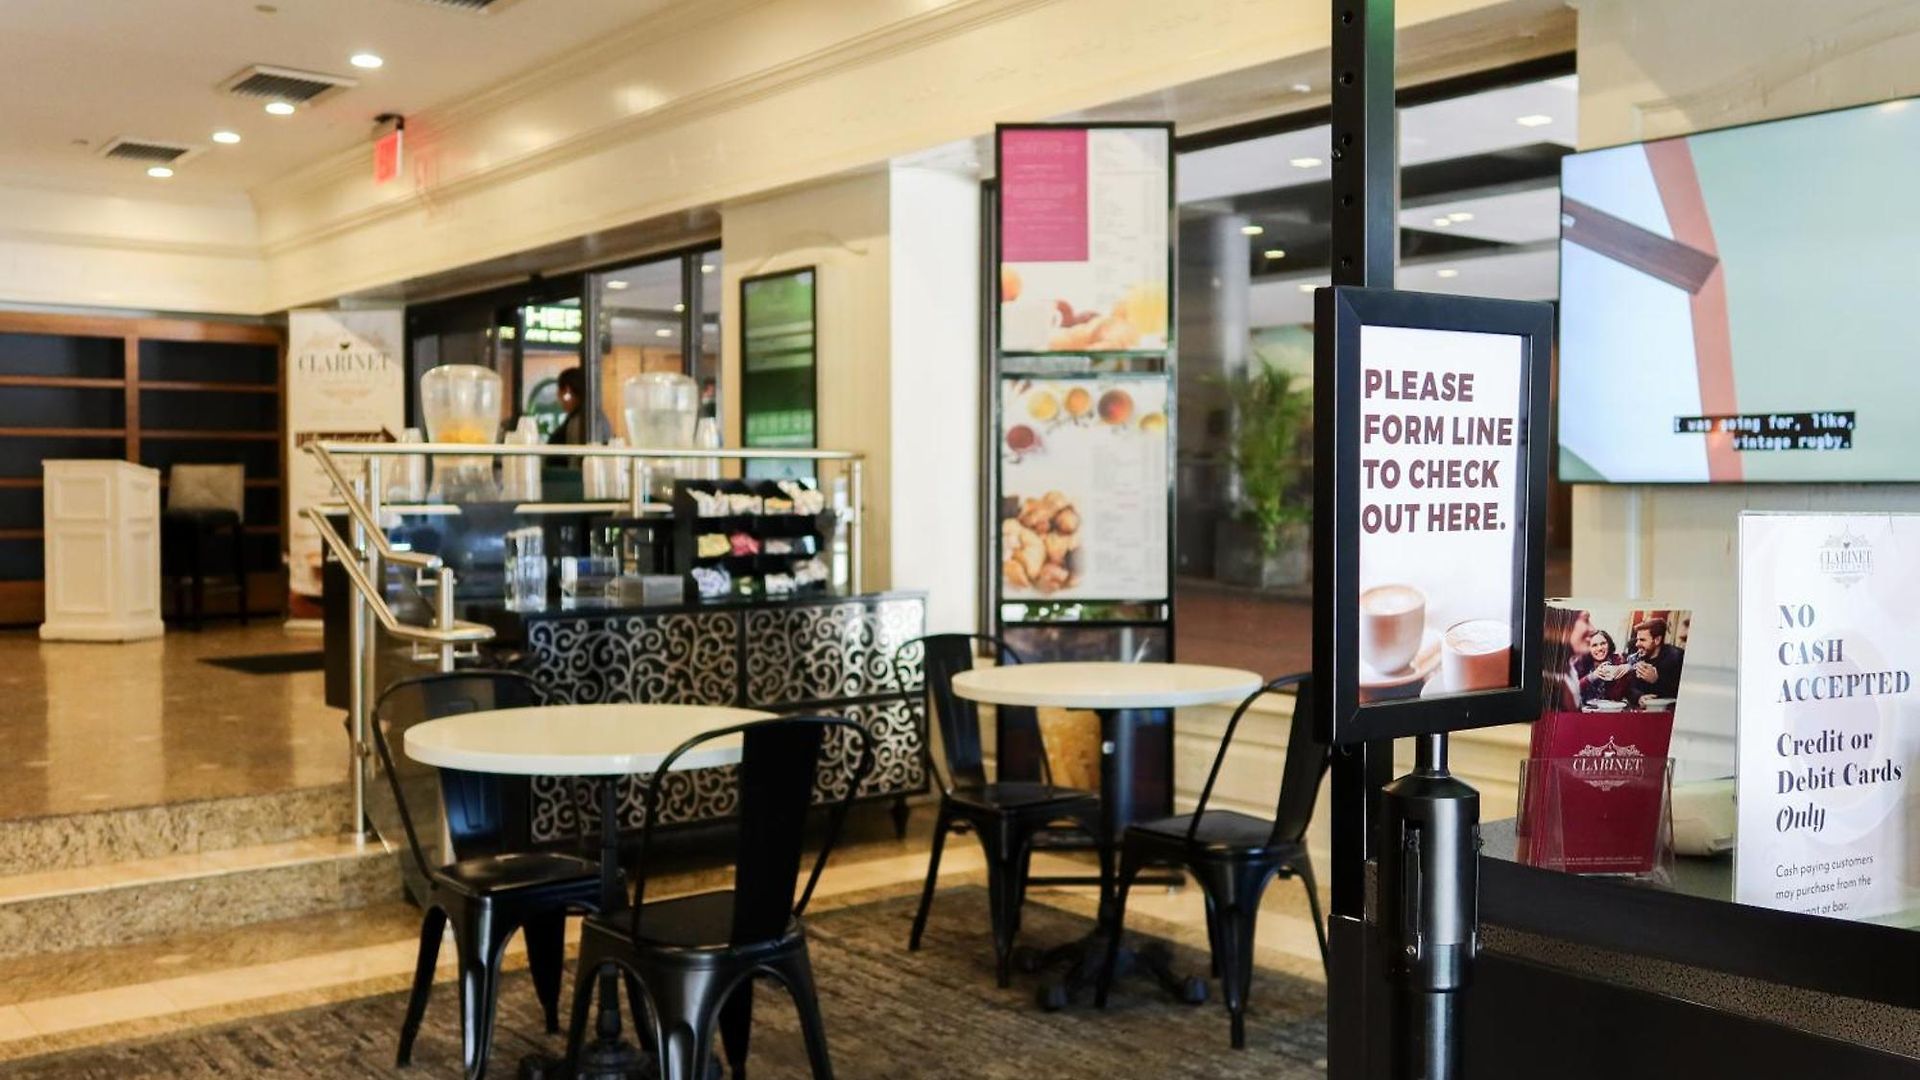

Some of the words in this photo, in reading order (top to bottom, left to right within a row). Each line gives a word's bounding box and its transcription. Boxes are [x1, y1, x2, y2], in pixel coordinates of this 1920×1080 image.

[298, 352, 391, 373] CLARINET
[1365, 369, 1474, 402] PLEASE
[1364, 414, 1444, 445] FORM
[1452, 417, 1513, 445] LINE
[1687, 419, 1712, 431] was
[1719, 417, 1760, 433] going
[1811, 413, 1853, 430] like,
[1733, 434, 1791, 450] vintage
[1798, 433, 1850, 450] rugby.
[1363, 459, 1401, 489] TO
[1409, 460, 1500, 488] CHECK
[1362, 504, 1420, 534] OUT
[1427, 502, 1506, 532] HERE.
[1820, 550, 1873, 564] CLARINET
[1778, 604, 1816, 629] NO
[1778, 639, 1844, 666] CASH
[1777, 670, 1911, 703] ACCEPTED
[1777, 729, 1844, 757] Credit
[1851, 732, 1873, 750] or
[1572, 758, 1644, 772] CLARINET
[1777, 766, 1835, 794] Debit
[1843, 759, 1902, 786] Cards
[1776, 803, 1825, 832] Only
[1776, 863, 1798, 878] Cash
[1800, 861, 1830, 876] paying
[1832, 855, 1874, 870] customers
[1776, 888, 1794, 900] may
[1796, 882, 1835, 900] purchase
[1837, 876, 1854, 889] from
[1855, 875, 1872, 888] the
[1822, 905, 1831, 914] or
